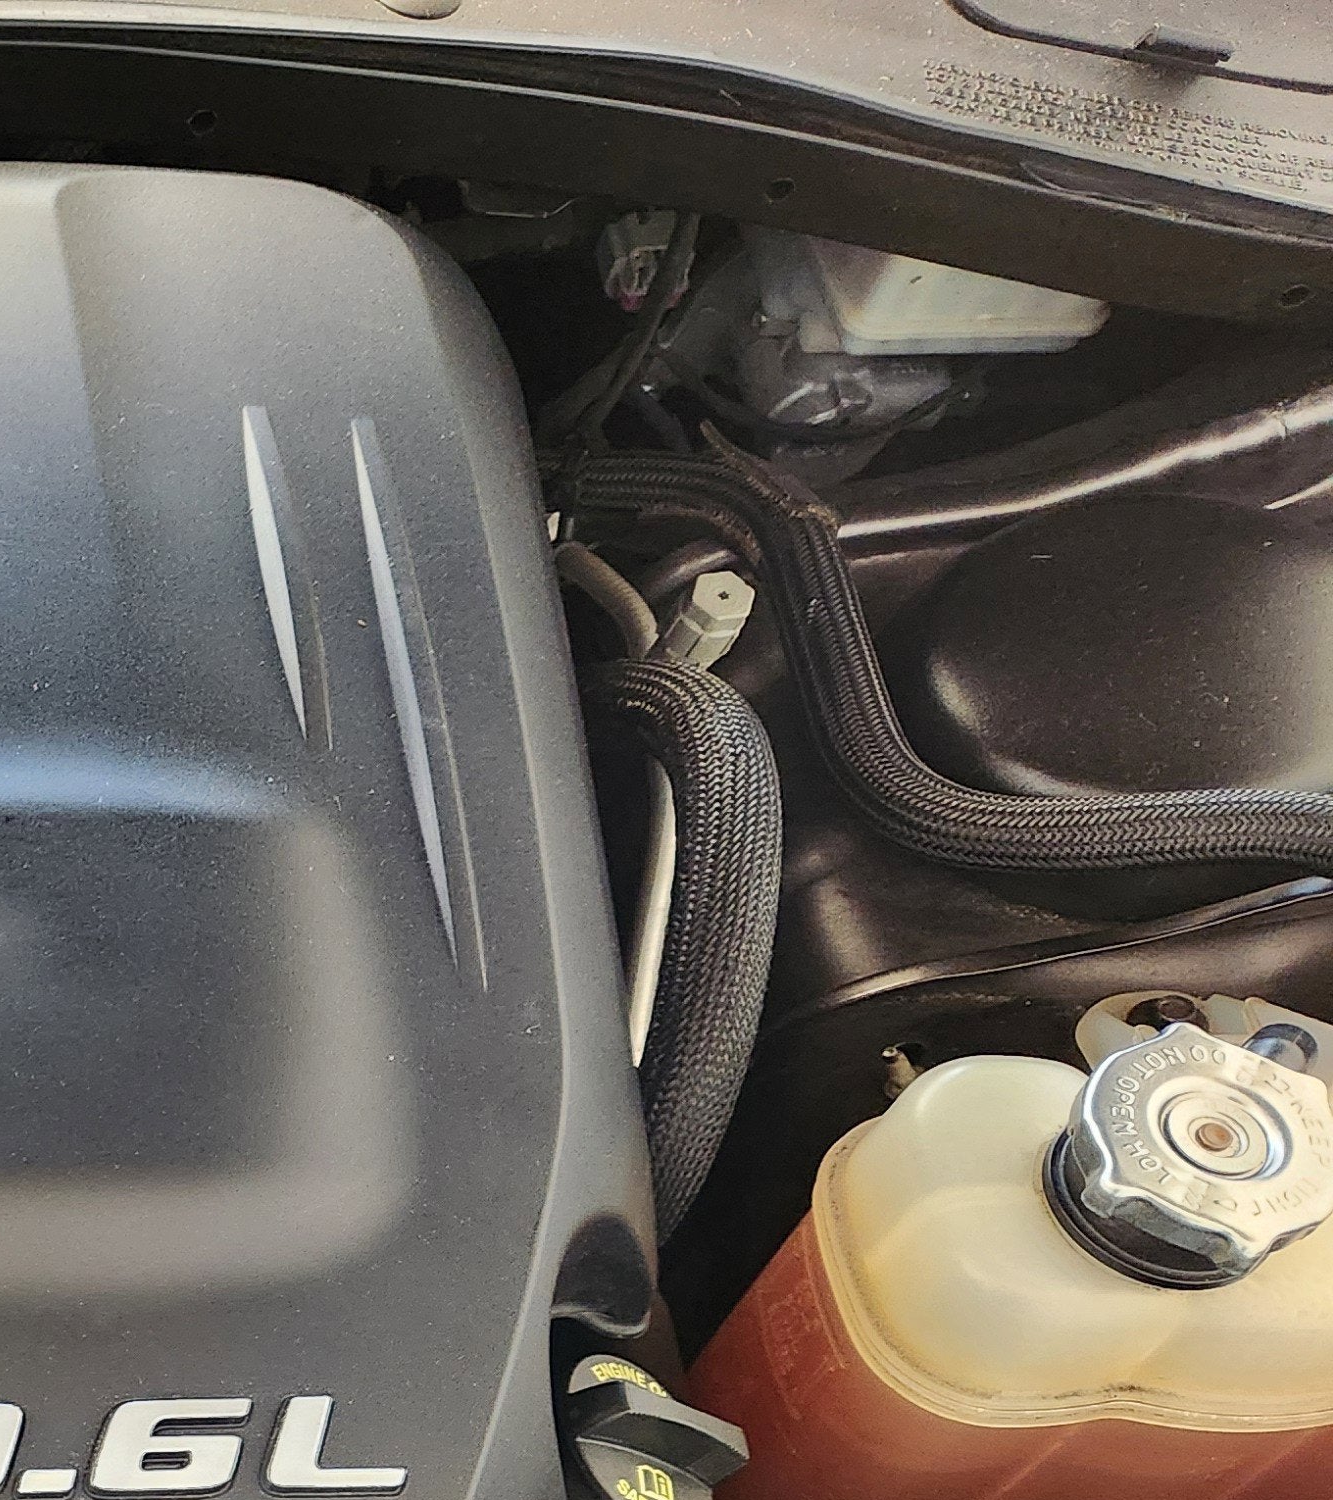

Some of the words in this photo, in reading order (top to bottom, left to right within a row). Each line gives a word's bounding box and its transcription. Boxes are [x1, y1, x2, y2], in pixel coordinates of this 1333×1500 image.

[1132, 1045, 1187, 1080] NOT
[1188, 1044, 1227, 1066] DO
[1110, 1076, 1142, 1138] OPEN
[1122, 1137, 1174, 1185] HOT
[590, 1361, 649, 1390] ENGINE
